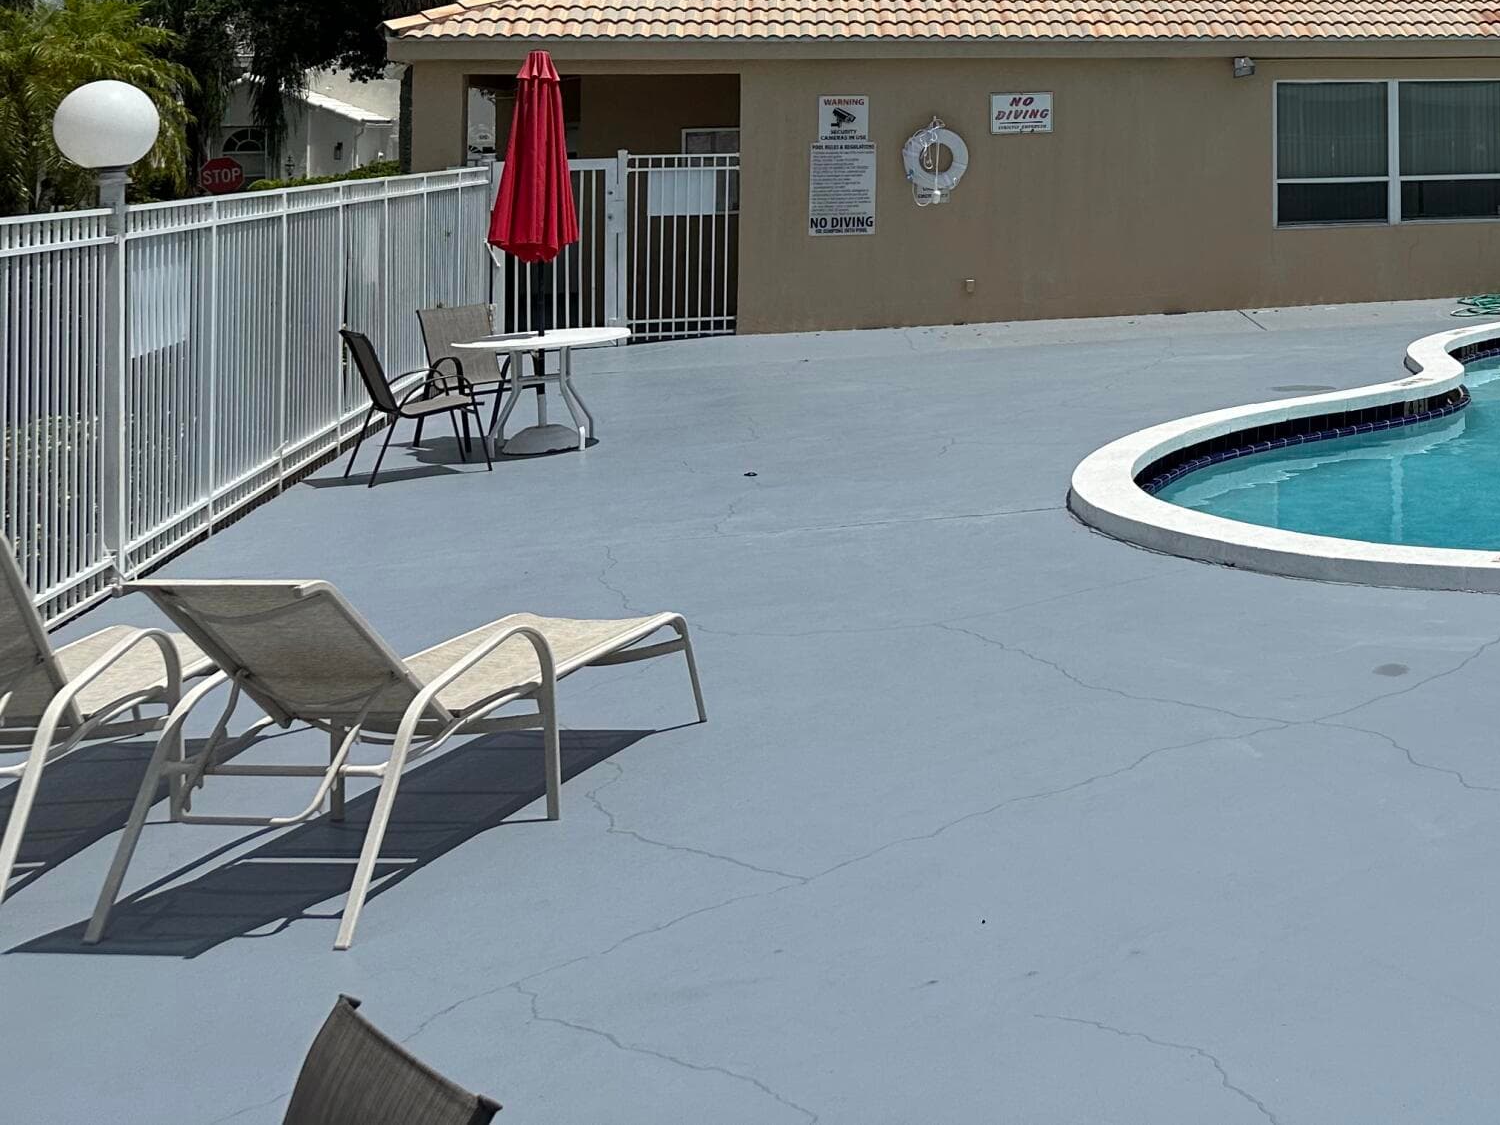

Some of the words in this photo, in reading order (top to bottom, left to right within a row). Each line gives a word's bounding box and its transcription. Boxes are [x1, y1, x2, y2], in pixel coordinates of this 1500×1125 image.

[823, 98, 865, 106] WARNING
[1009, 96, 1034, 107] NO
[995, 108, 1050, 121] DIVING
[202, 167, 241, 185] STOP
[810, 216, 828, 229] NO
[831, 215, 874, 228] DIVING
